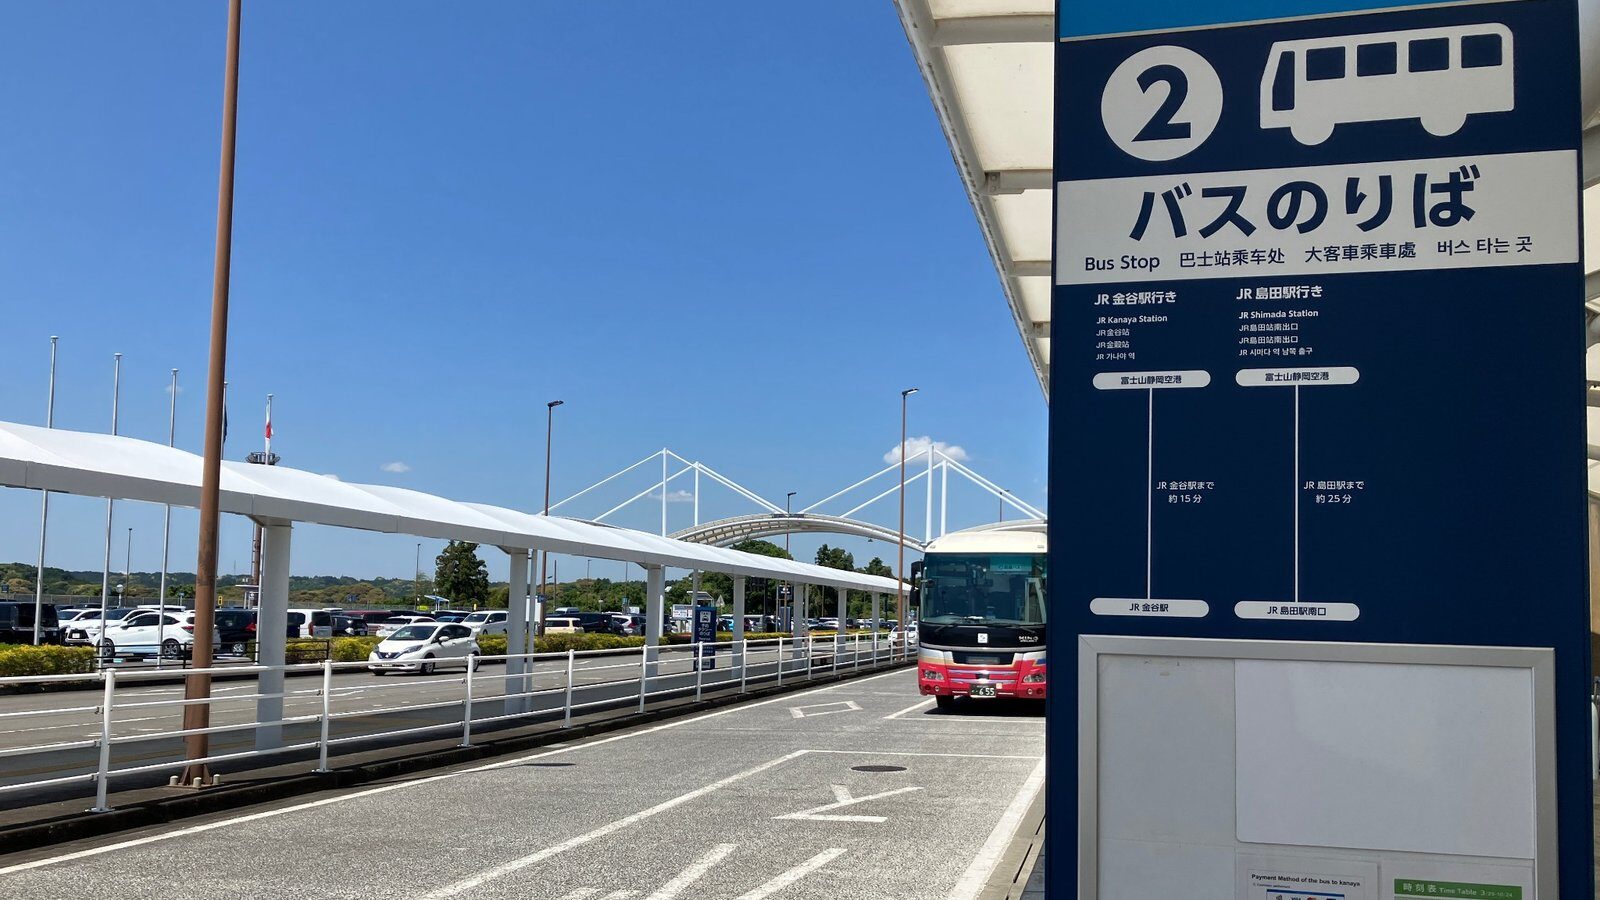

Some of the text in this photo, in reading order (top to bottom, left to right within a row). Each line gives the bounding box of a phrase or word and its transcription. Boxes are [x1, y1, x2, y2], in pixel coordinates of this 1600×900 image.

[1131, 64, 1191, 142] 2
[1129, 164, 1481, 242] バスのりば
[1437, 236, 1533, 256] 버스 타는 곳
[1305, 241, 1417, 263] 大客車乘車處
[1085, 255, 1160, 272] Bus Stop
[1180, 248, 1285, 268] 巴士站乘车处
[1236, 285, 1323, 300] JR 島田駅行き
[1094, 291, 1177, 306] JR 金谷駅行き
[1096, 314, 1168, 325] JR Kanaya Station
[1238, 309, 1319, 319] JR Shimada Station
[1096, 353, 1104, 361] JR
[1120, 375, 1182, 385] 富士山静岡空港
[1265, 371, 1329, 382] 富士山静岡空港
[1156, 481, 1215, 490] JR 金谷駅まで
[1303, 481, 1365, 490] JR 島田駅まで
[1129, 603, 1169, 613] JR 金谷駅
[1267, 606, 1278, 615] JR
[1252, 873, 1277, 881] Payment
[1458, 888, 1477, 896] Table
